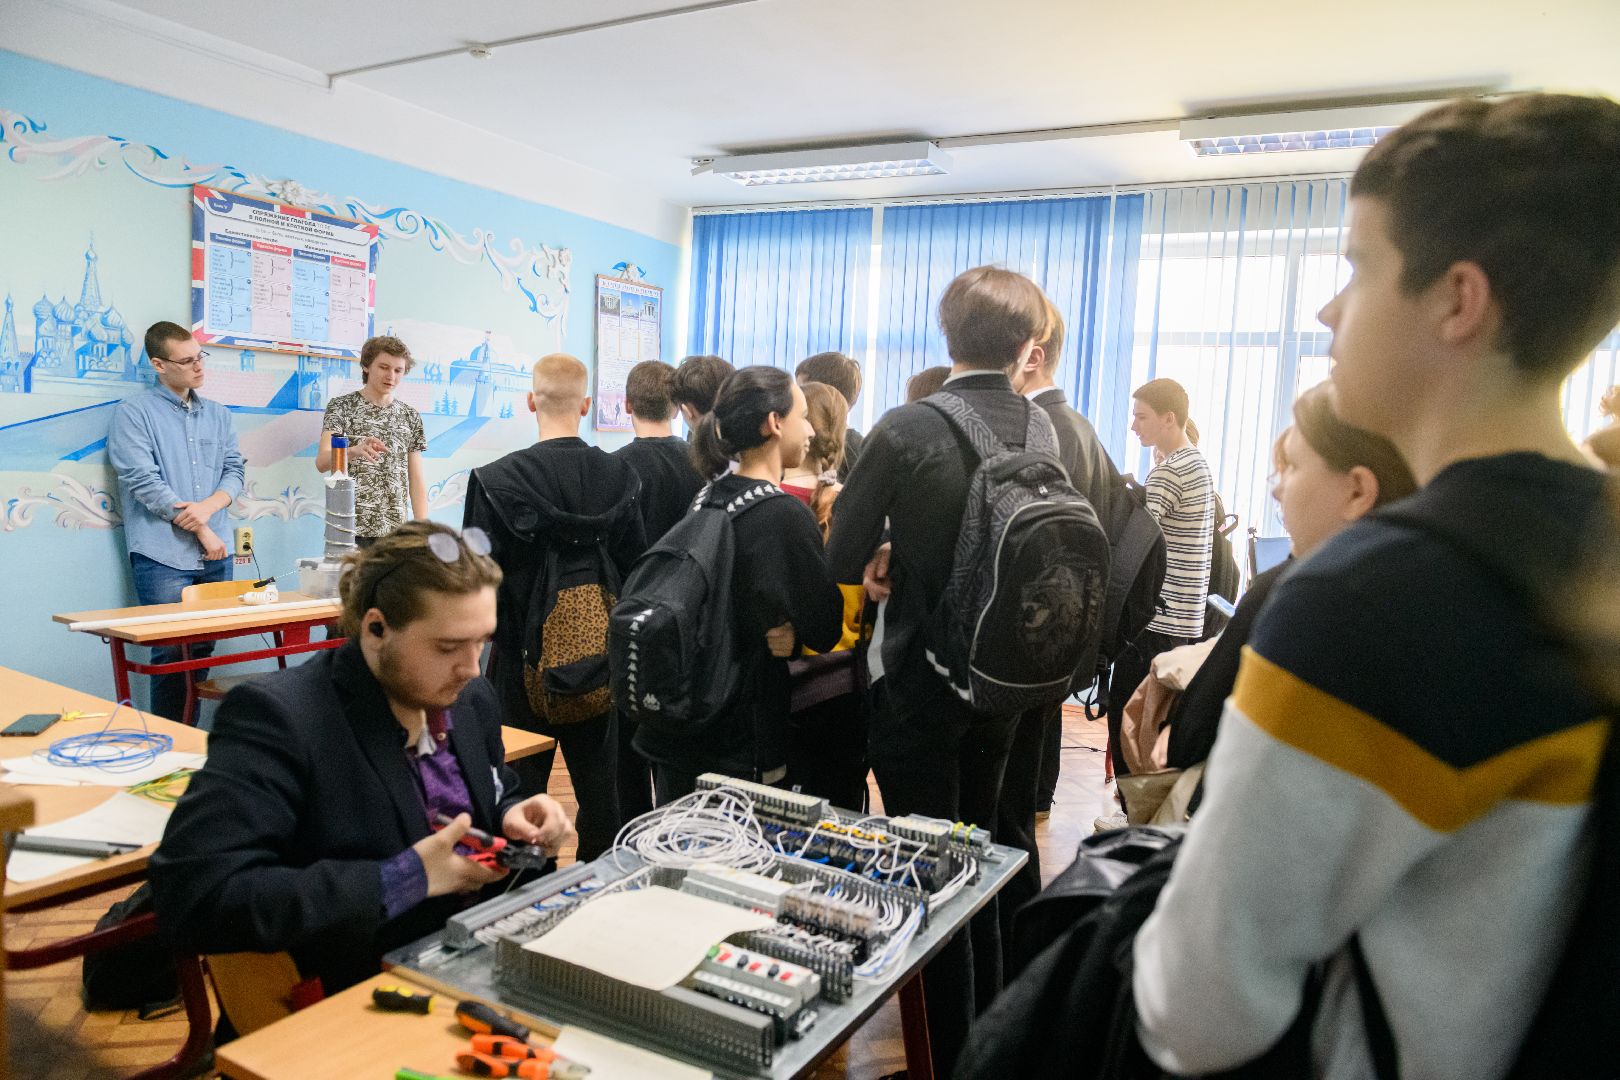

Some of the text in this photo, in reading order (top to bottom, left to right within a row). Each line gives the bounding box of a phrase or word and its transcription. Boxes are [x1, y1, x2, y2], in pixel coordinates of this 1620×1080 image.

[252, 209, 290, 222] СПРЯЖЕНИЕ
[290, 216, 316, 227] ГЛАГОЛА
[254, 215, 280, 225] ПОЛНОЙ
[286, 222, 313, 233] КРАТКОЙ
